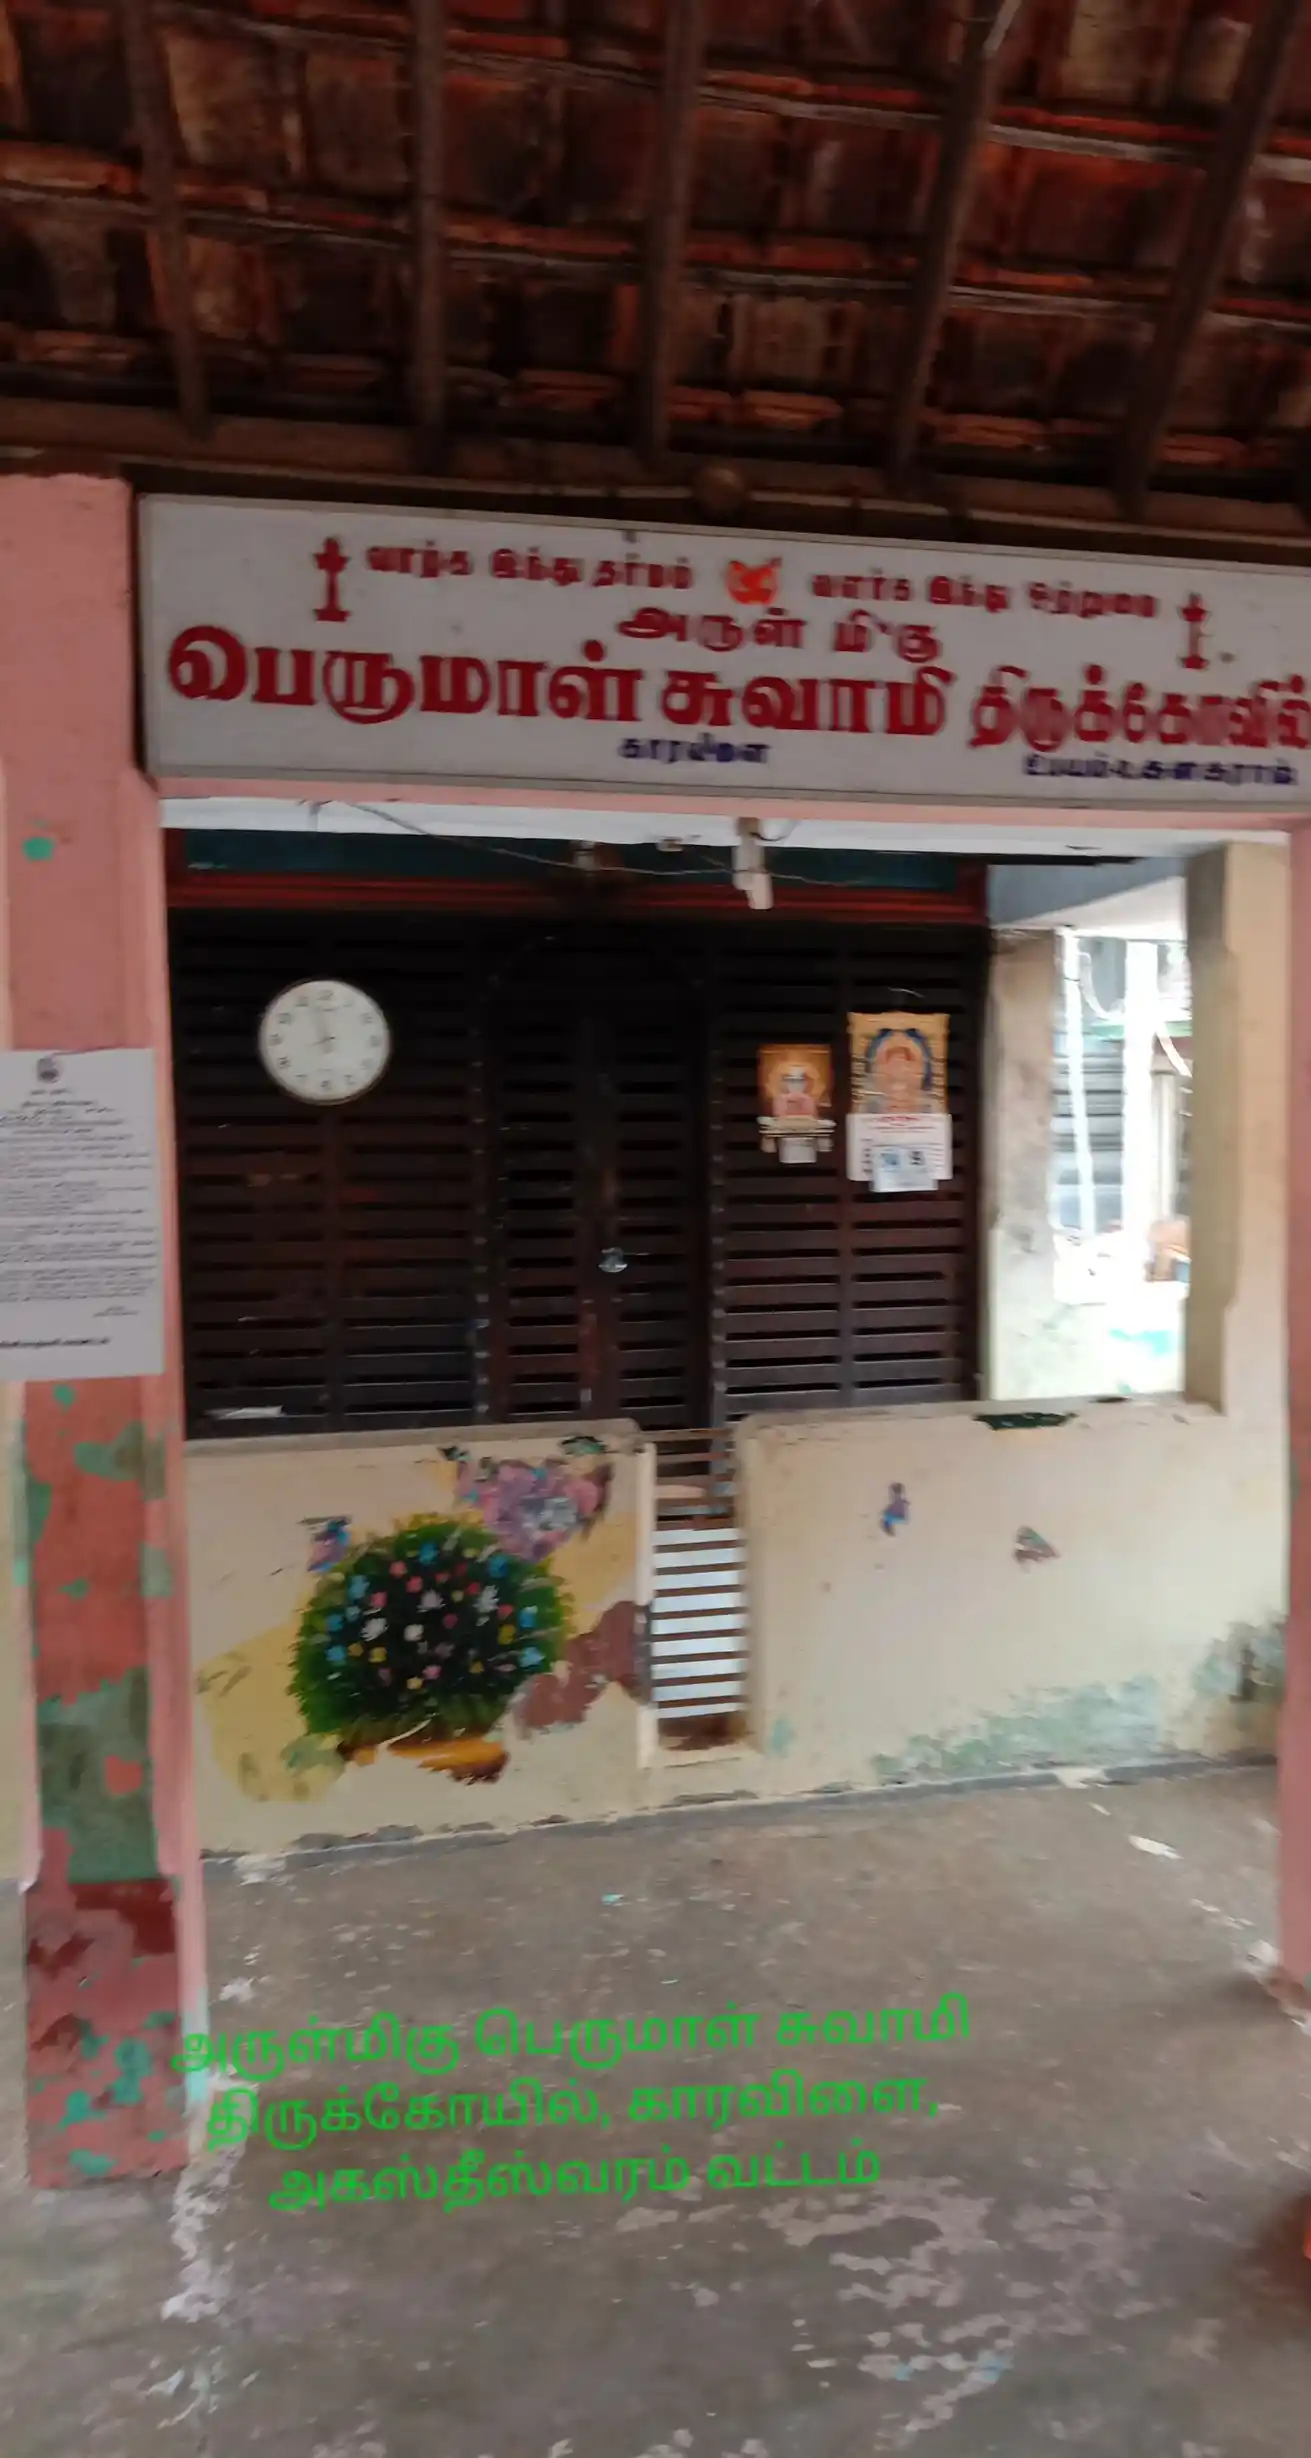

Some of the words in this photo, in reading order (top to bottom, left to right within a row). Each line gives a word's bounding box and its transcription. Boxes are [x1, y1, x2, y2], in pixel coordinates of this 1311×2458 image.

[617, 606, 807, 652] அருள்
[167, 624, 644, 725] பெருமாள்
[661, 665, 958, 737] சுவாமி
